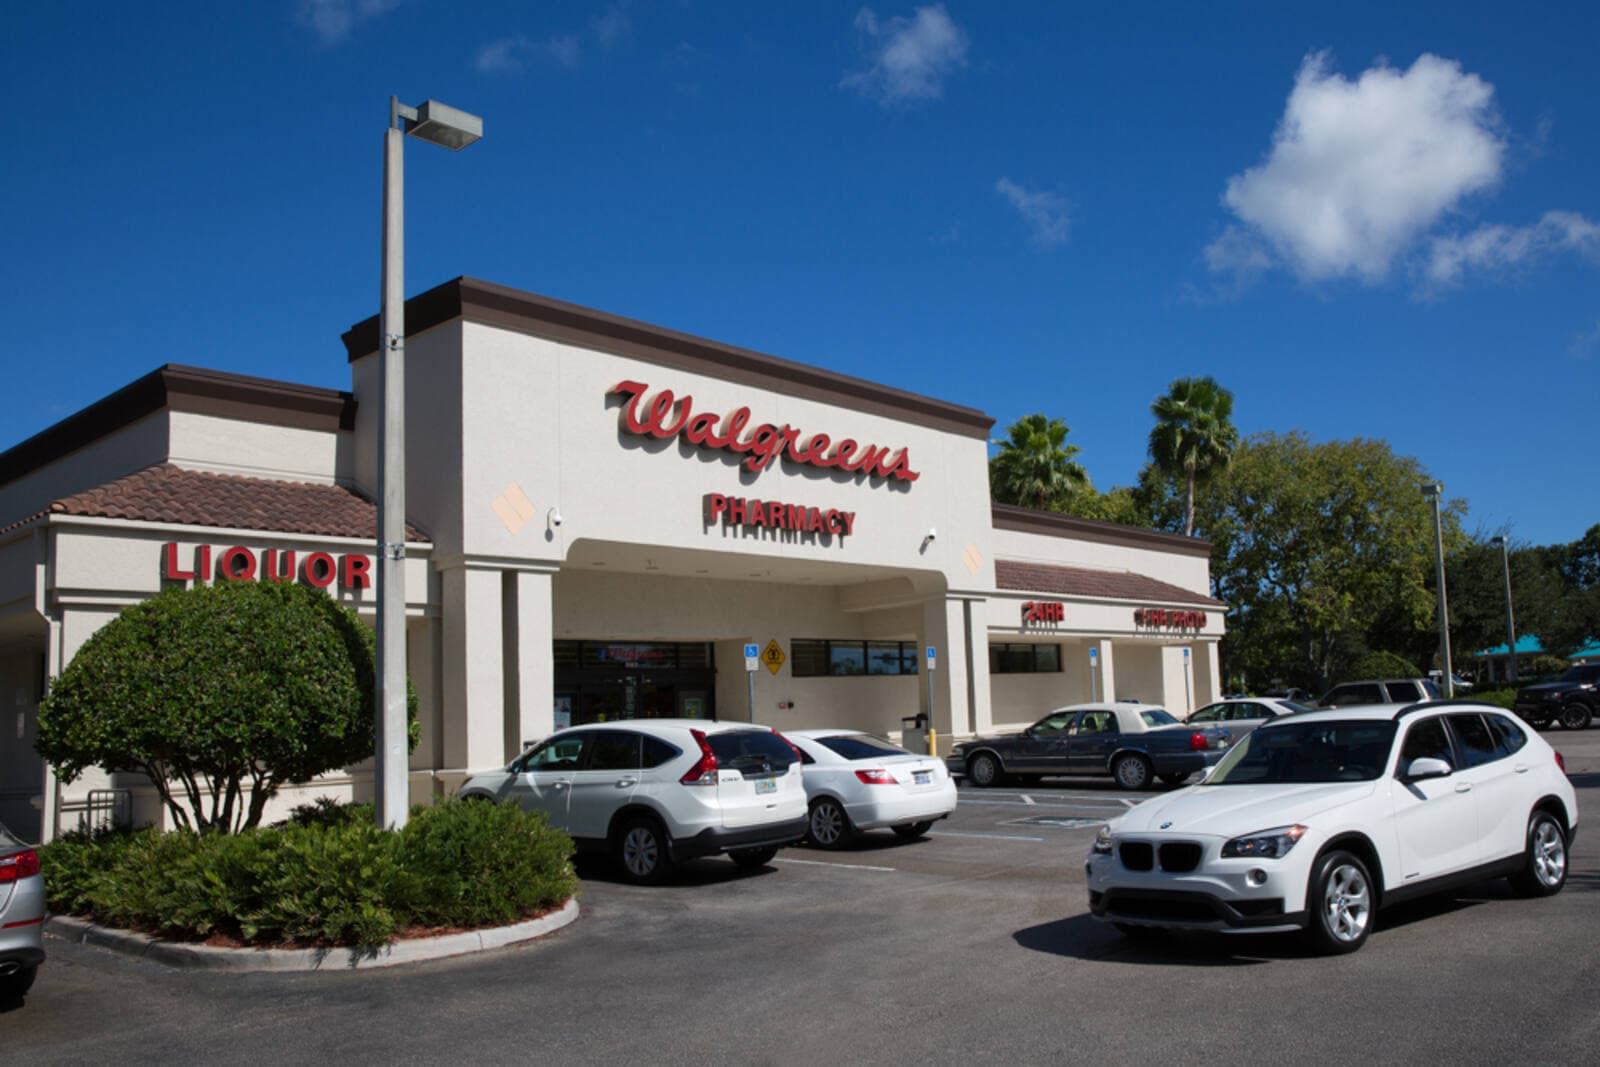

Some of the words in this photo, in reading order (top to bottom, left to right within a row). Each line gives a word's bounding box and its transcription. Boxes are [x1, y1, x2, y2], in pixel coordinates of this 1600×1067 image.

[613, 379, 920, 482] Walgreens
[710, 492, 856, 537] PHARMACY
[166, 542, 371, 589] LIQUOR
[1026, 600, 1065, 622] 24HR
